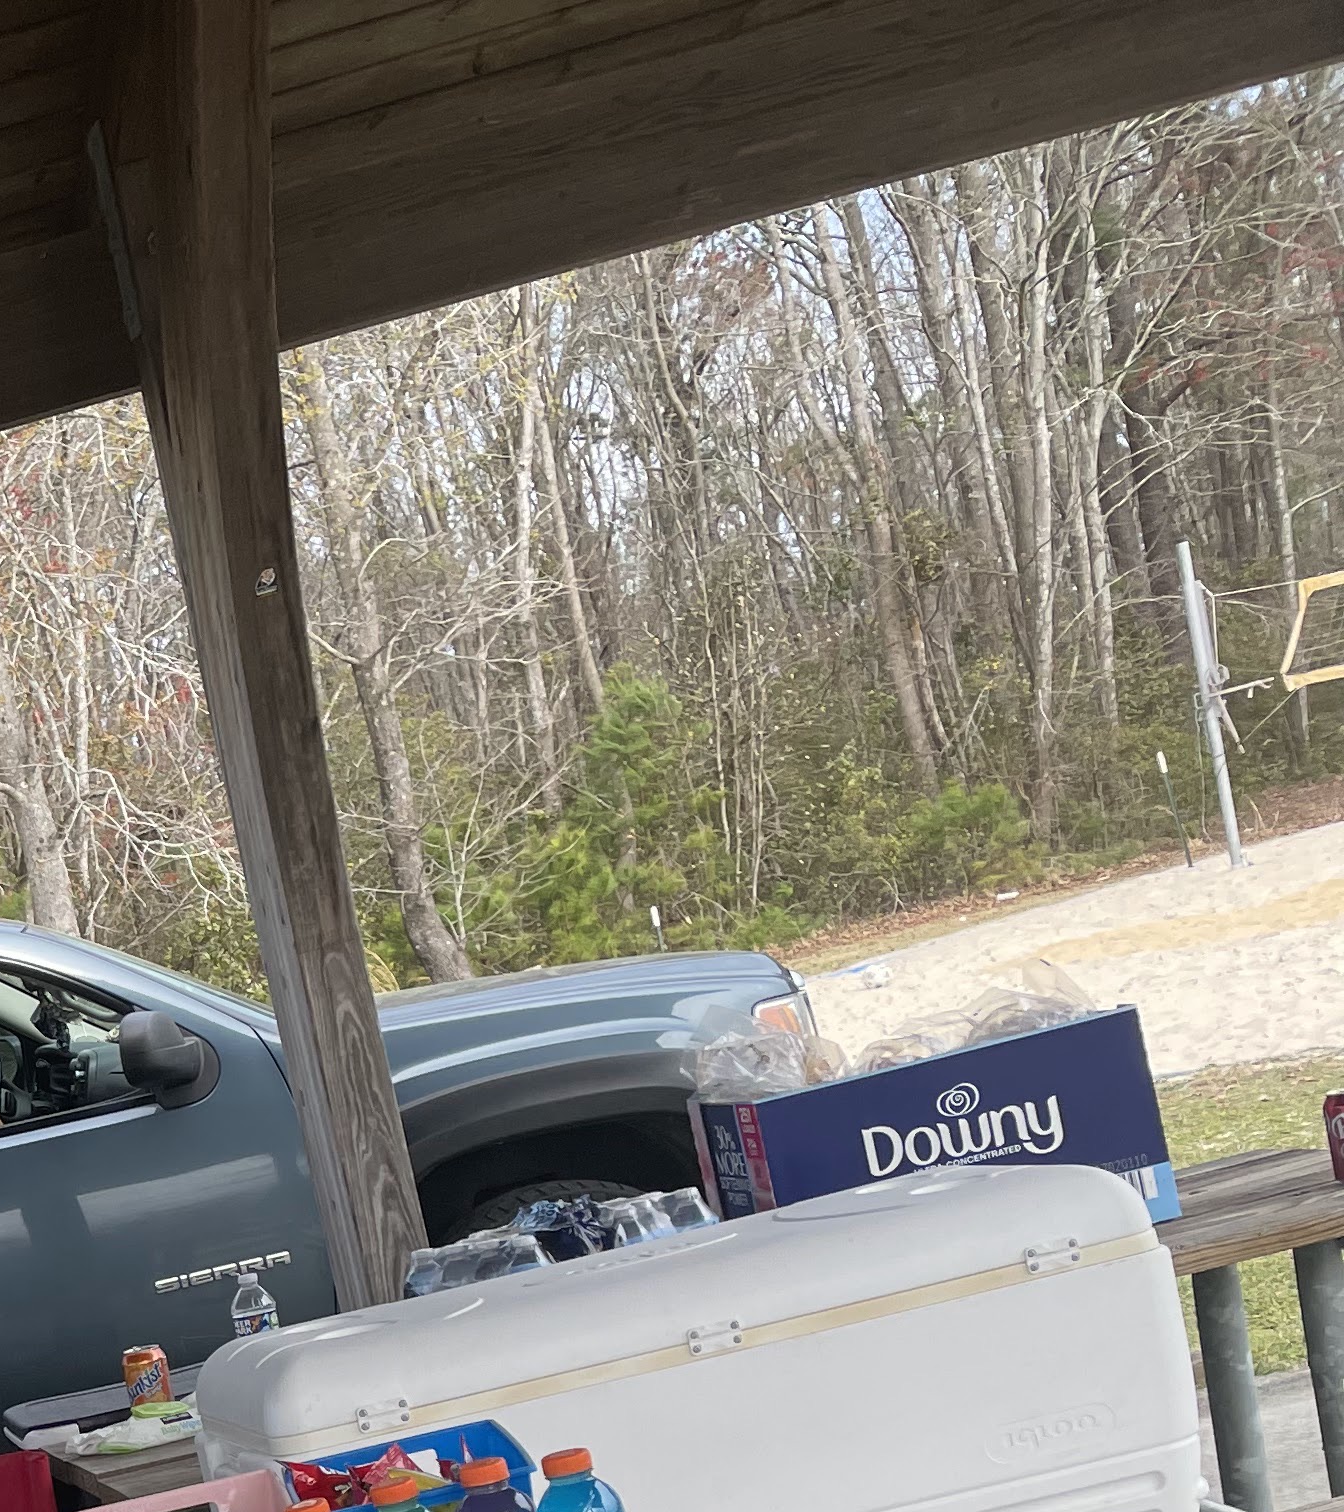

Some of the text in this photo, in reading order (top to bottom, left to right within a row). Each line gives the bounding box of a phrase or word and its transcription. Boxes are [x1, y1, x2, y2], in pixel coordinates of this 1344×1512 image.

[861, 1095, 1064, 1178] Downy
[715, 1152, 749, 1177] MORE
[154, 1250, 292, 1294] SIERRA
